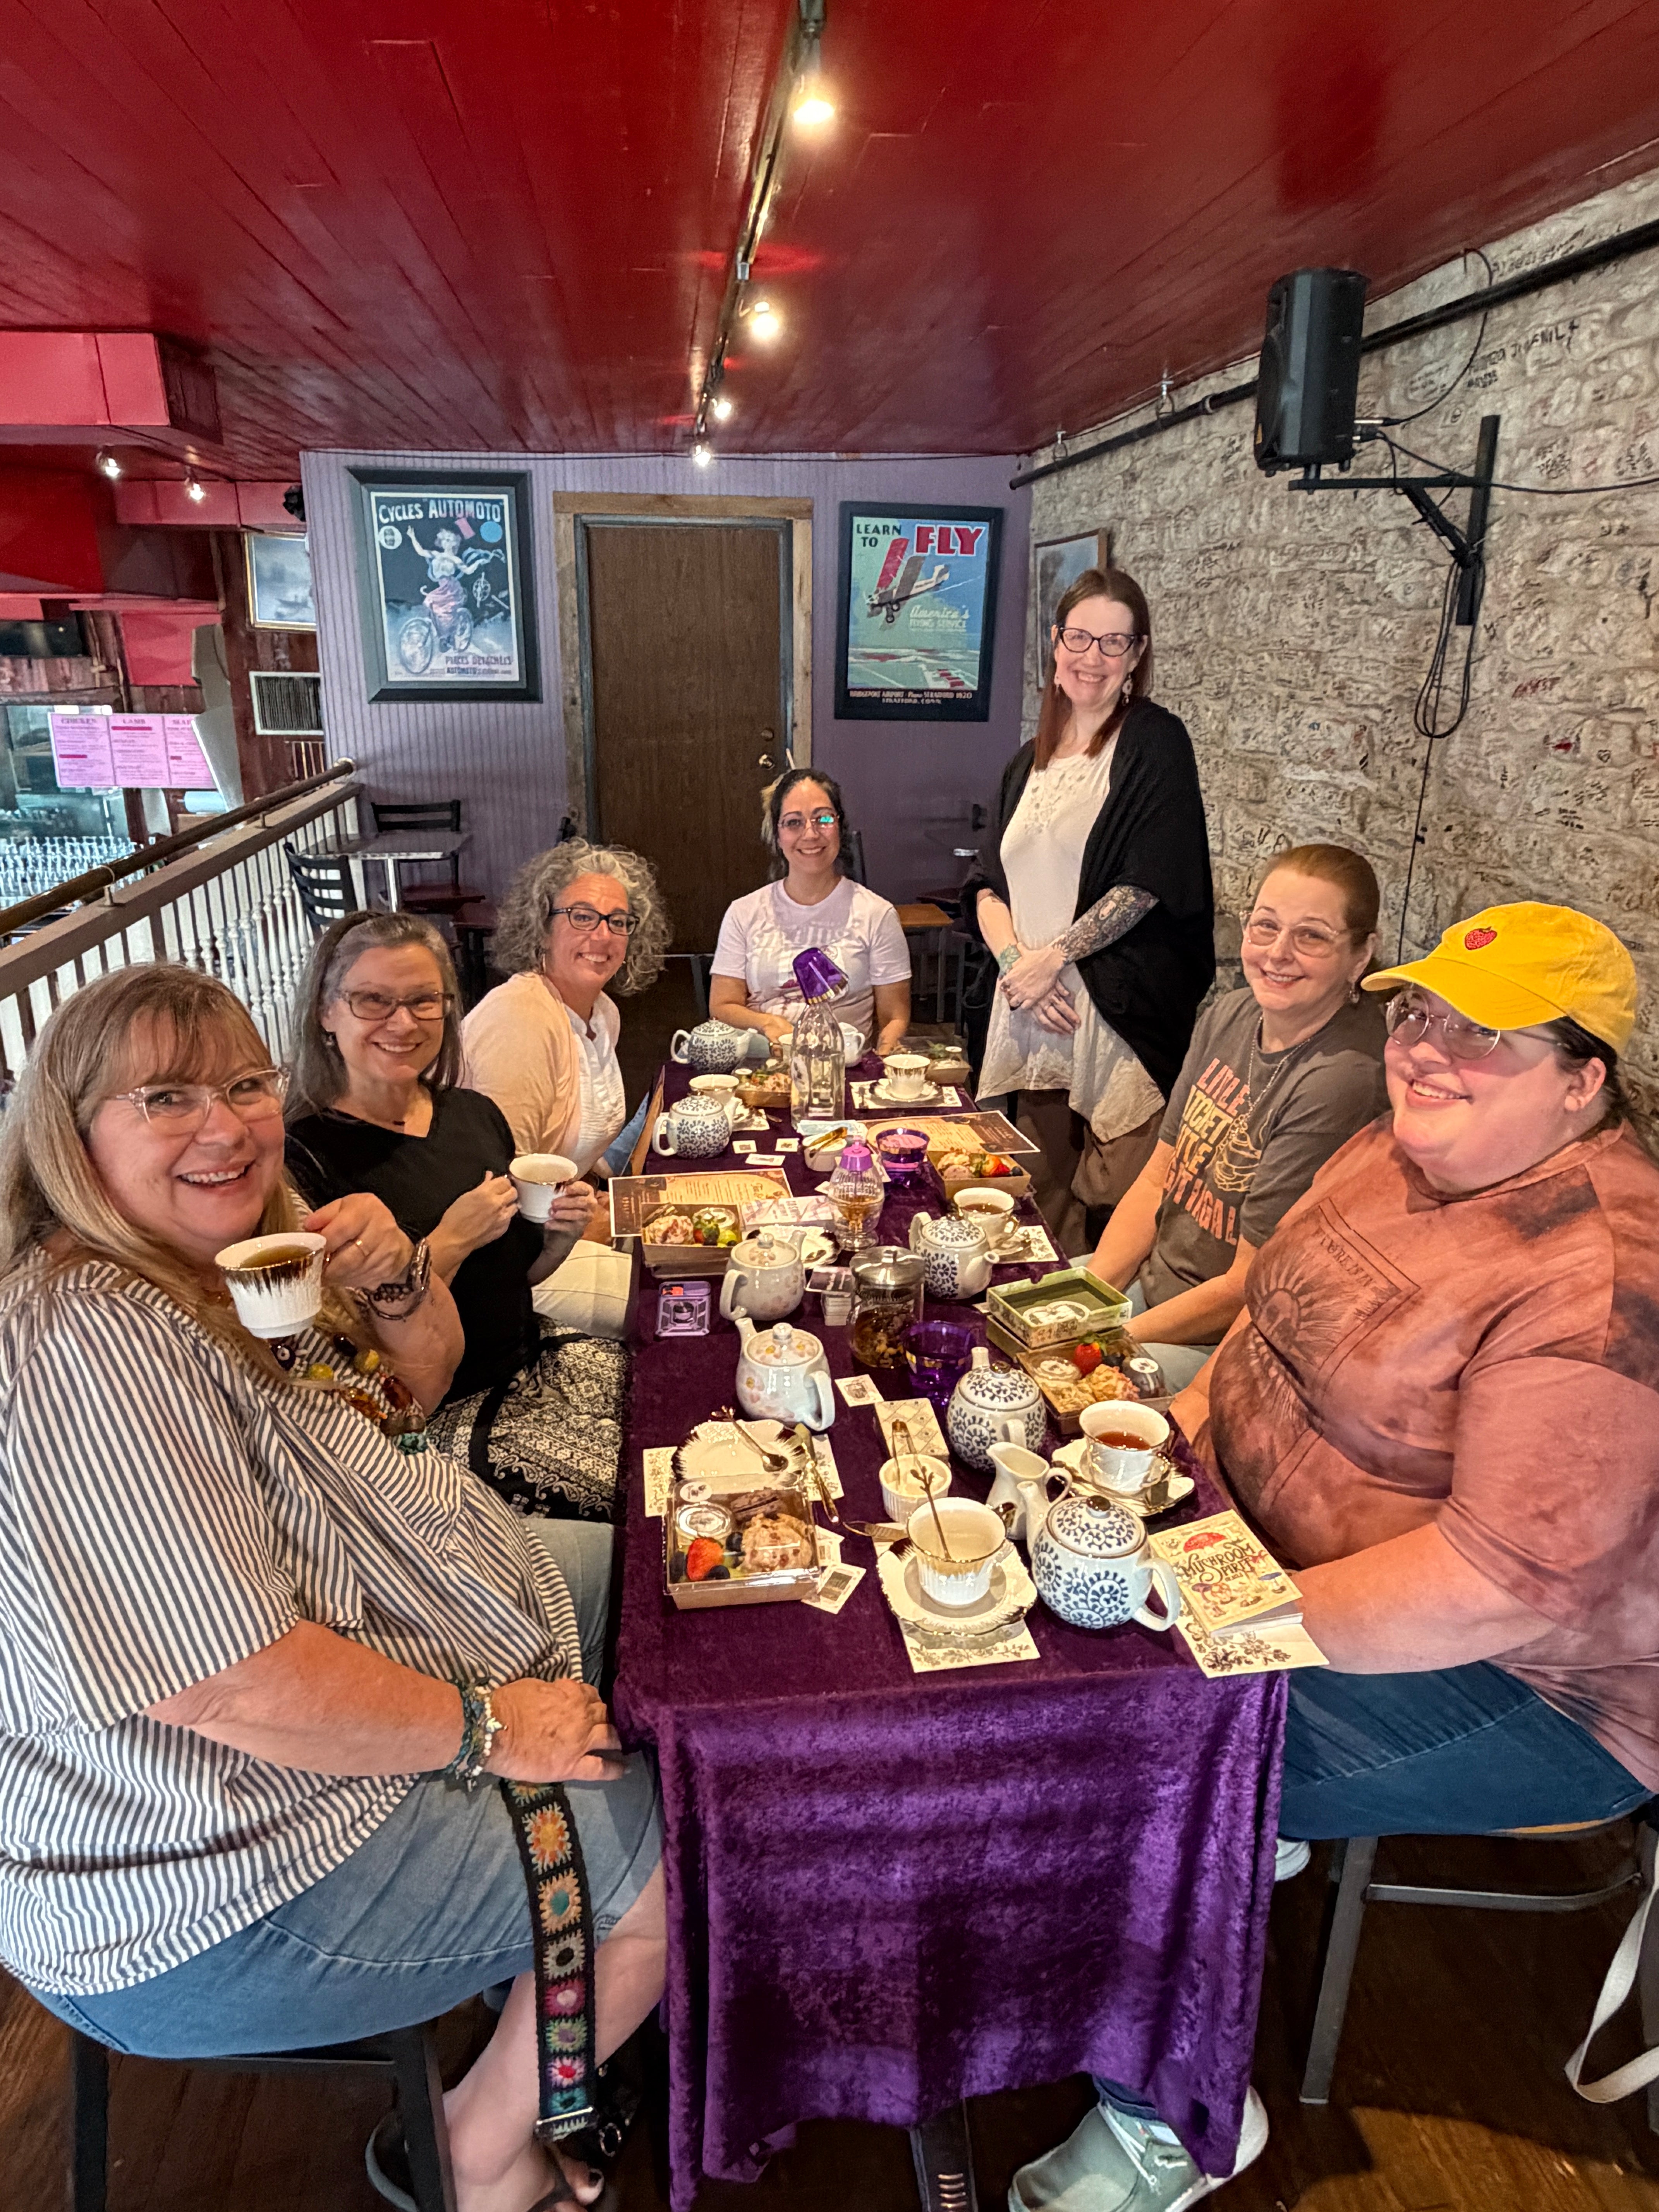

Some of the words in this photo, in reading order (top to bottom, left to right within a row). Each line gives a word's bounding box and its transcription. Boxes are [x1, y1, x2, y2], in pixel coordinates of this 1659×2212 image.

[379, 503, 424, 524] CYCLES
[856, 524, 902, 535] LEARN
[915, 524, 985, 555] FLY
[861, 537, 878, 547] TO
[1180, 1542, 1256, 1577] MUSHROOM
[1199, 1557, 1255, 1583] SPIRIT
